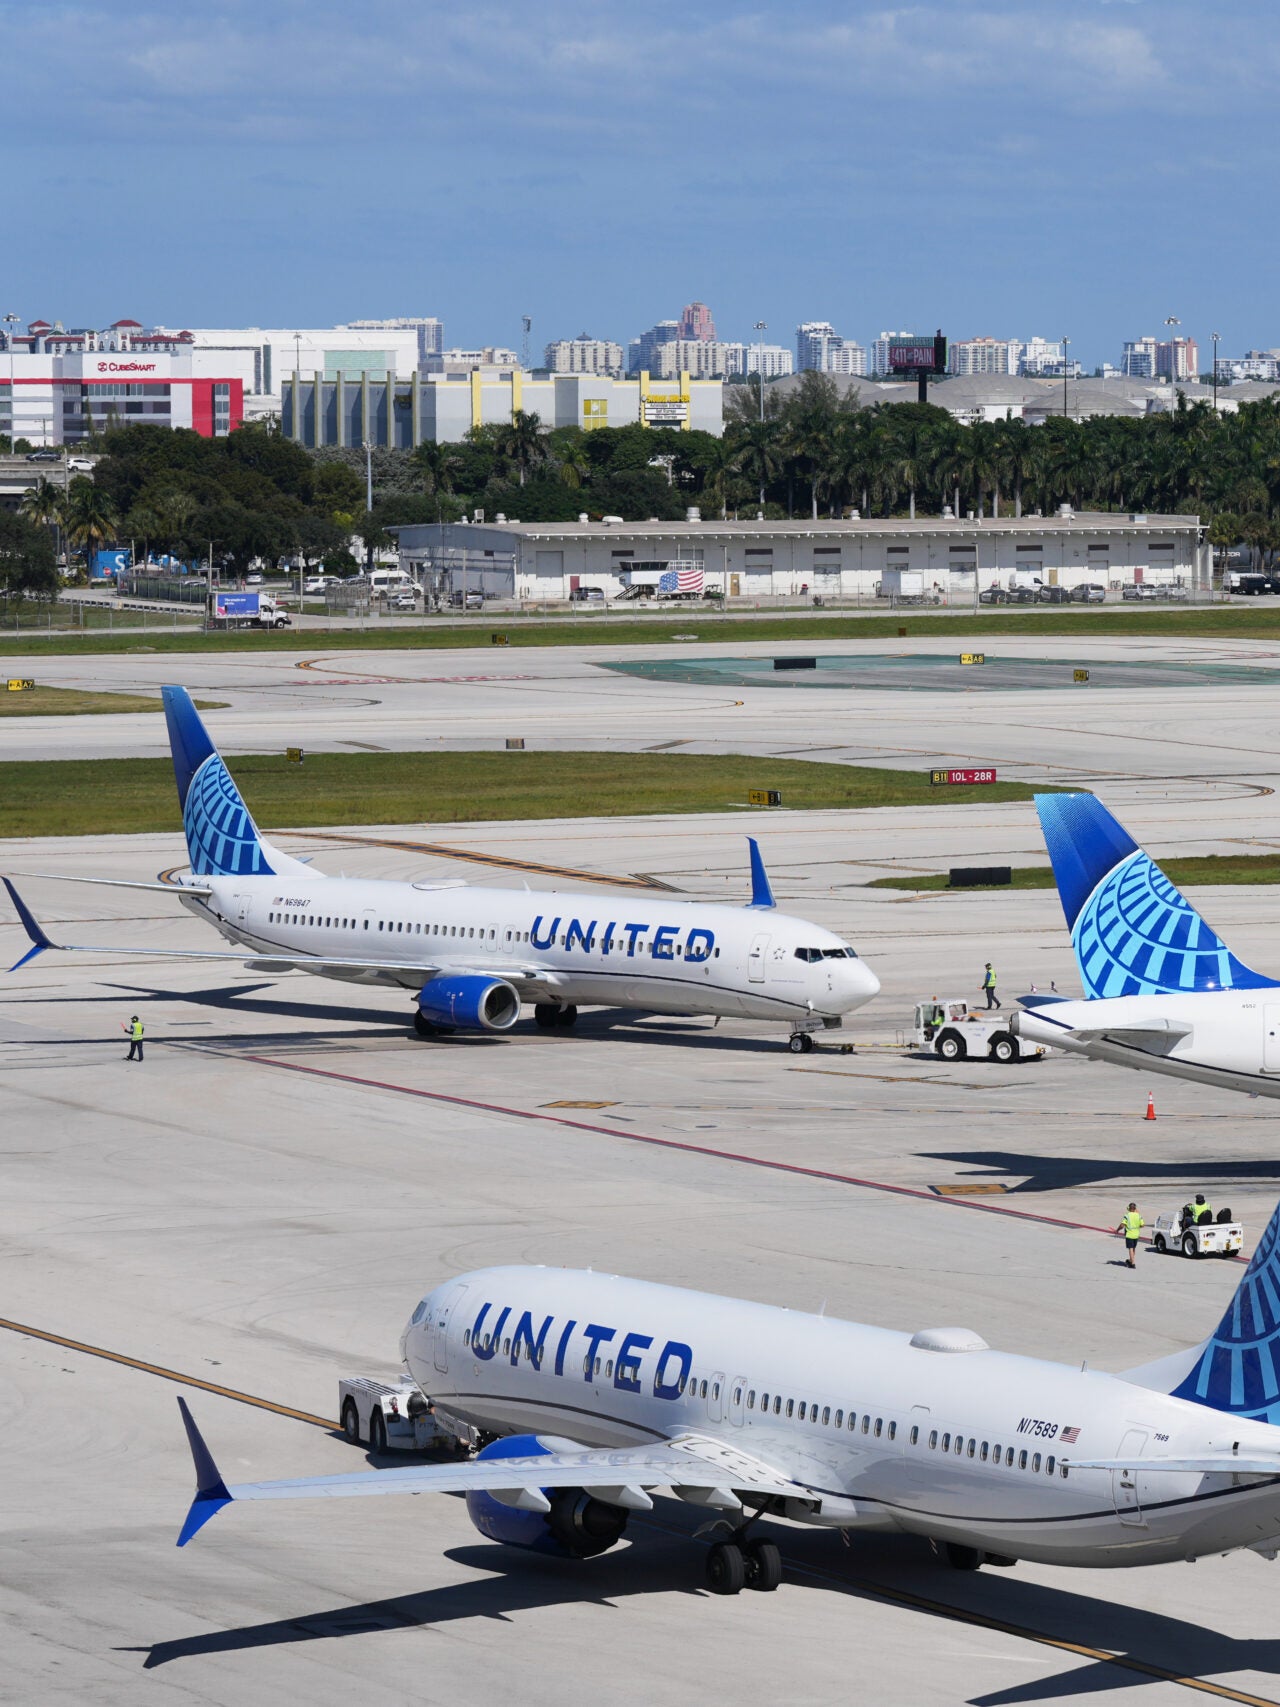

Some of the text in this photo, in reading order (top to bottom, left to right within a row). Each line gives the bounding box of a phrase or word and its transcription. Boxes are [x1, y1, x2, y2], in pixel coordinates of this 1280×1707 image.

[913, 348, 932, 363] PAIN
[934, 772, 947, 782] B11
[530, 916, 715, 963] UNITED
[471, 1302, 692, 1401] UNITED
[1016, 1417, 1058, 1439] N17589
[1153, 1433, 1170, 1442] 7589
